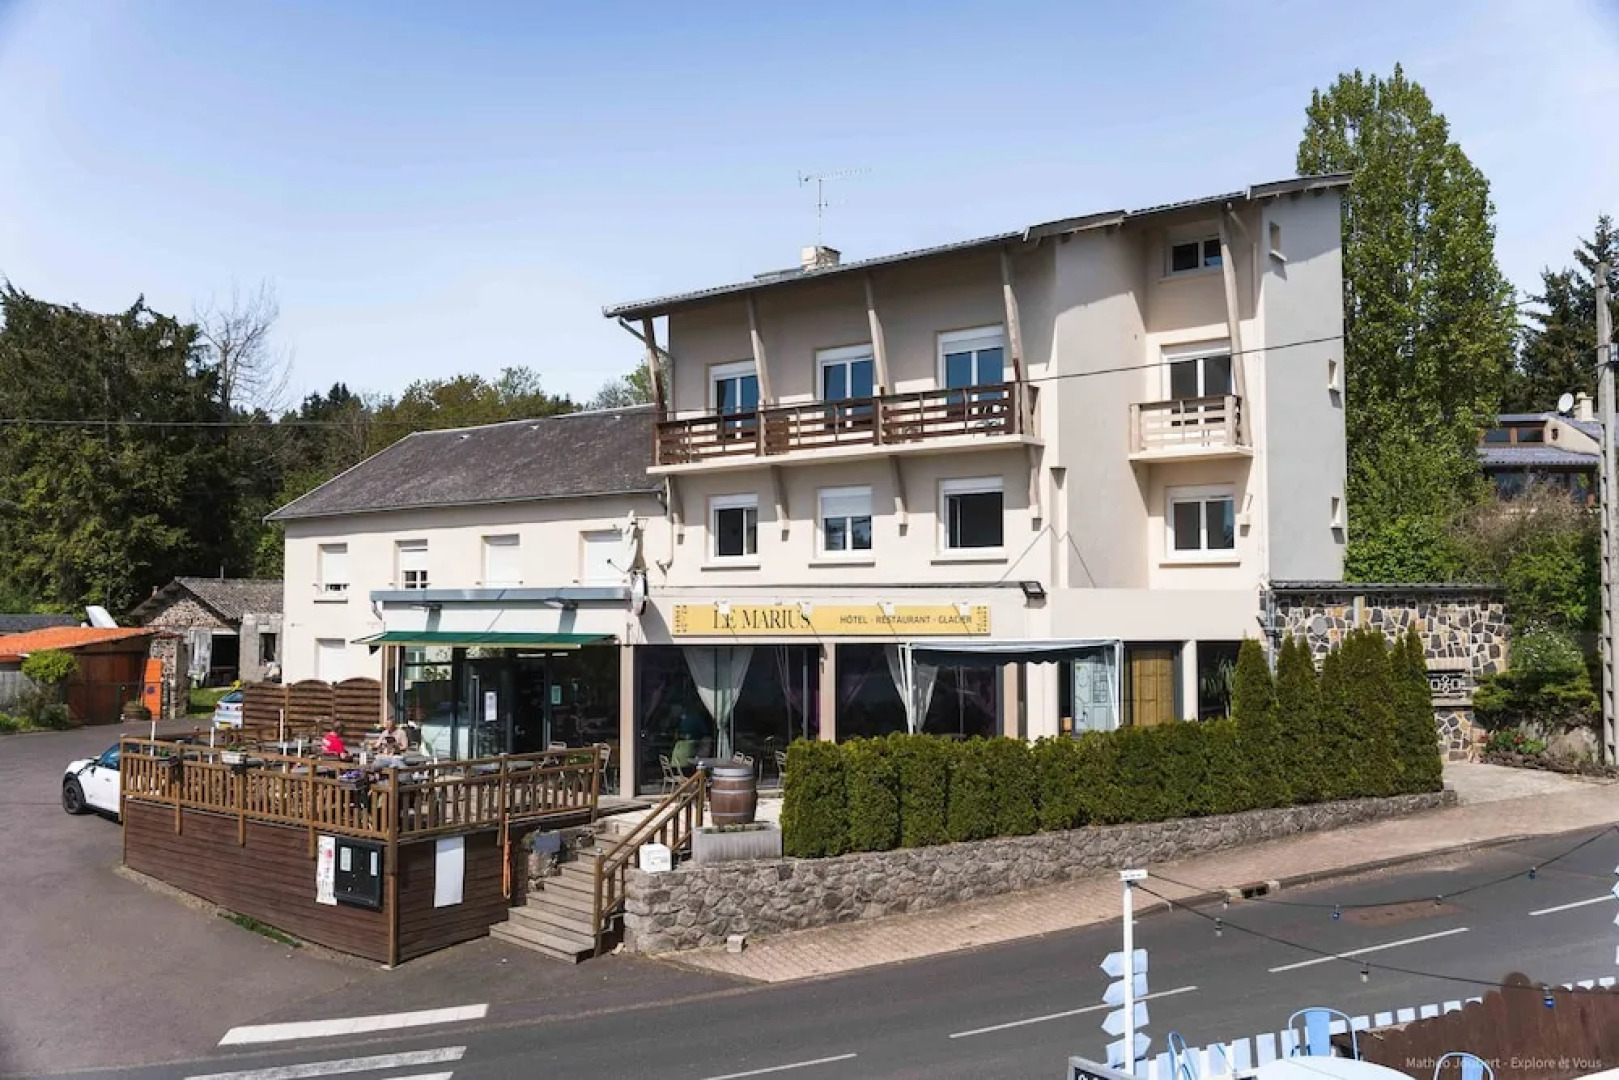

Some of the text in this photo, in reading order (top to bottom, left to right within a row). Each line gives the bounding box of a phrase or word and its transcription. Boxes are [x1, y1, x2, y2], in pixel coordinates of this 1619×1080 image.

[713, 609, 811, 629] LE MARIUS
[839, 613, 972, 624] HÔTEL RESTAURANT GLACIER
